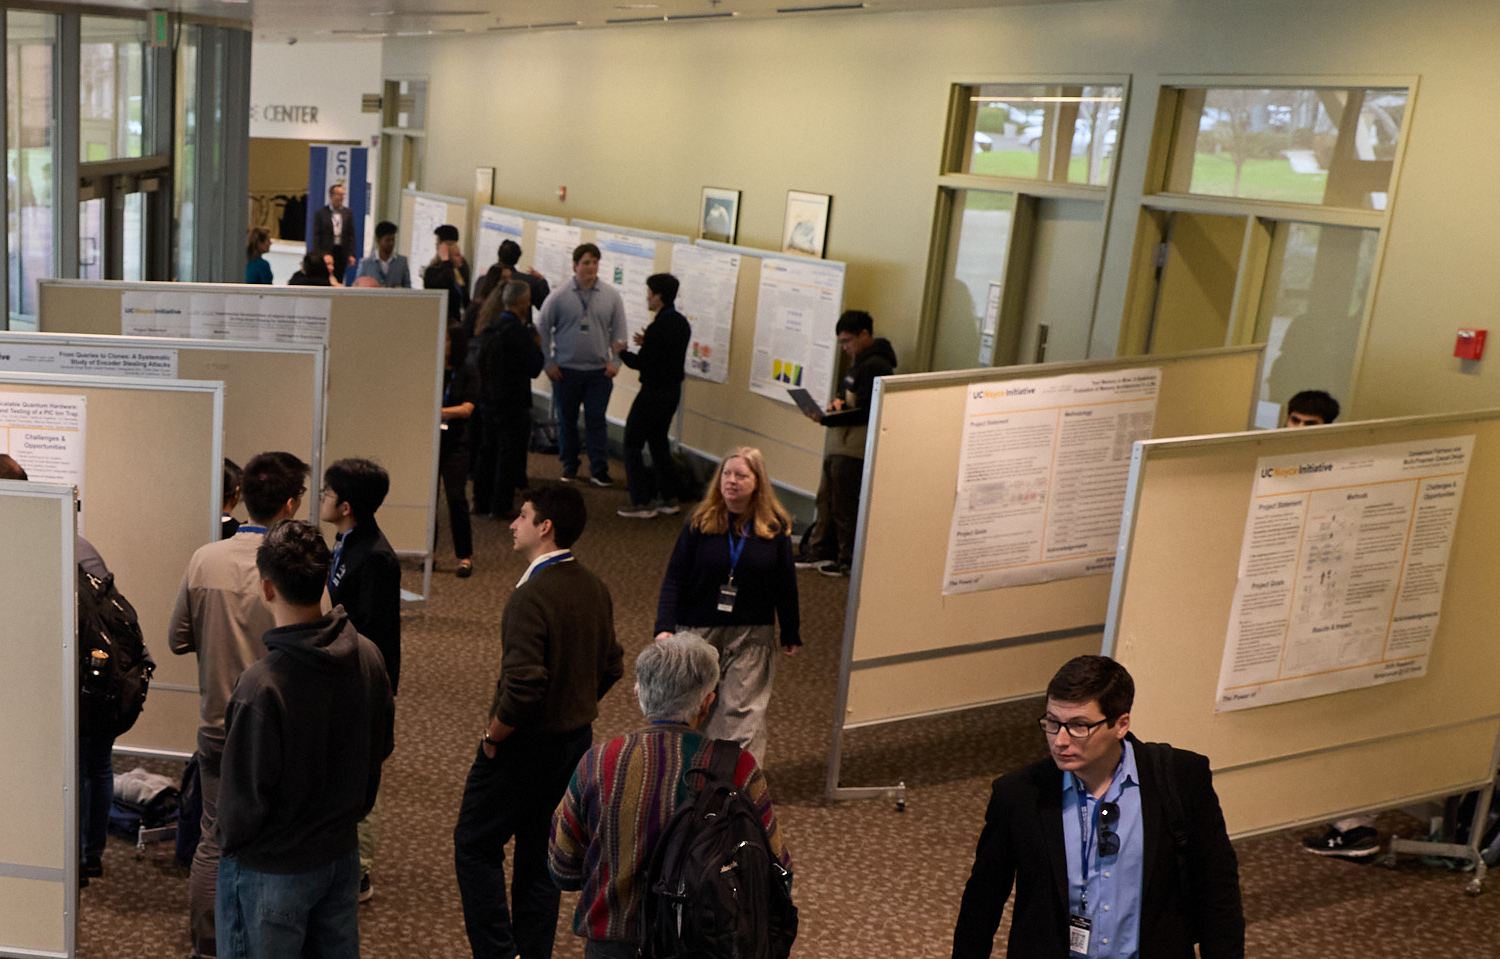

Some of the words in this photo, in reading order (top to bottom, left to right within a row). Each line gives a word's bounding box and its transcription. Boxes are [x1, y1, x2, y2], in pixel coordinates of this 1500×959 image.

[264, 105, 318, 123] CENTER
[336, 151, 347, 176] UC
[973, 391, 984, 399] UC
[1006, 387, 1036, 396] Initiative
[25, 434, 59, 442] Challenges
[24, 442, 66, 450] Opportunities
[1261, 468, 1273, 478] UC
[1298, 463, 1333, 474] Initiative
[1259, 503, 1276, 511] Project
[1277, 500, 1303, 509] Statement
